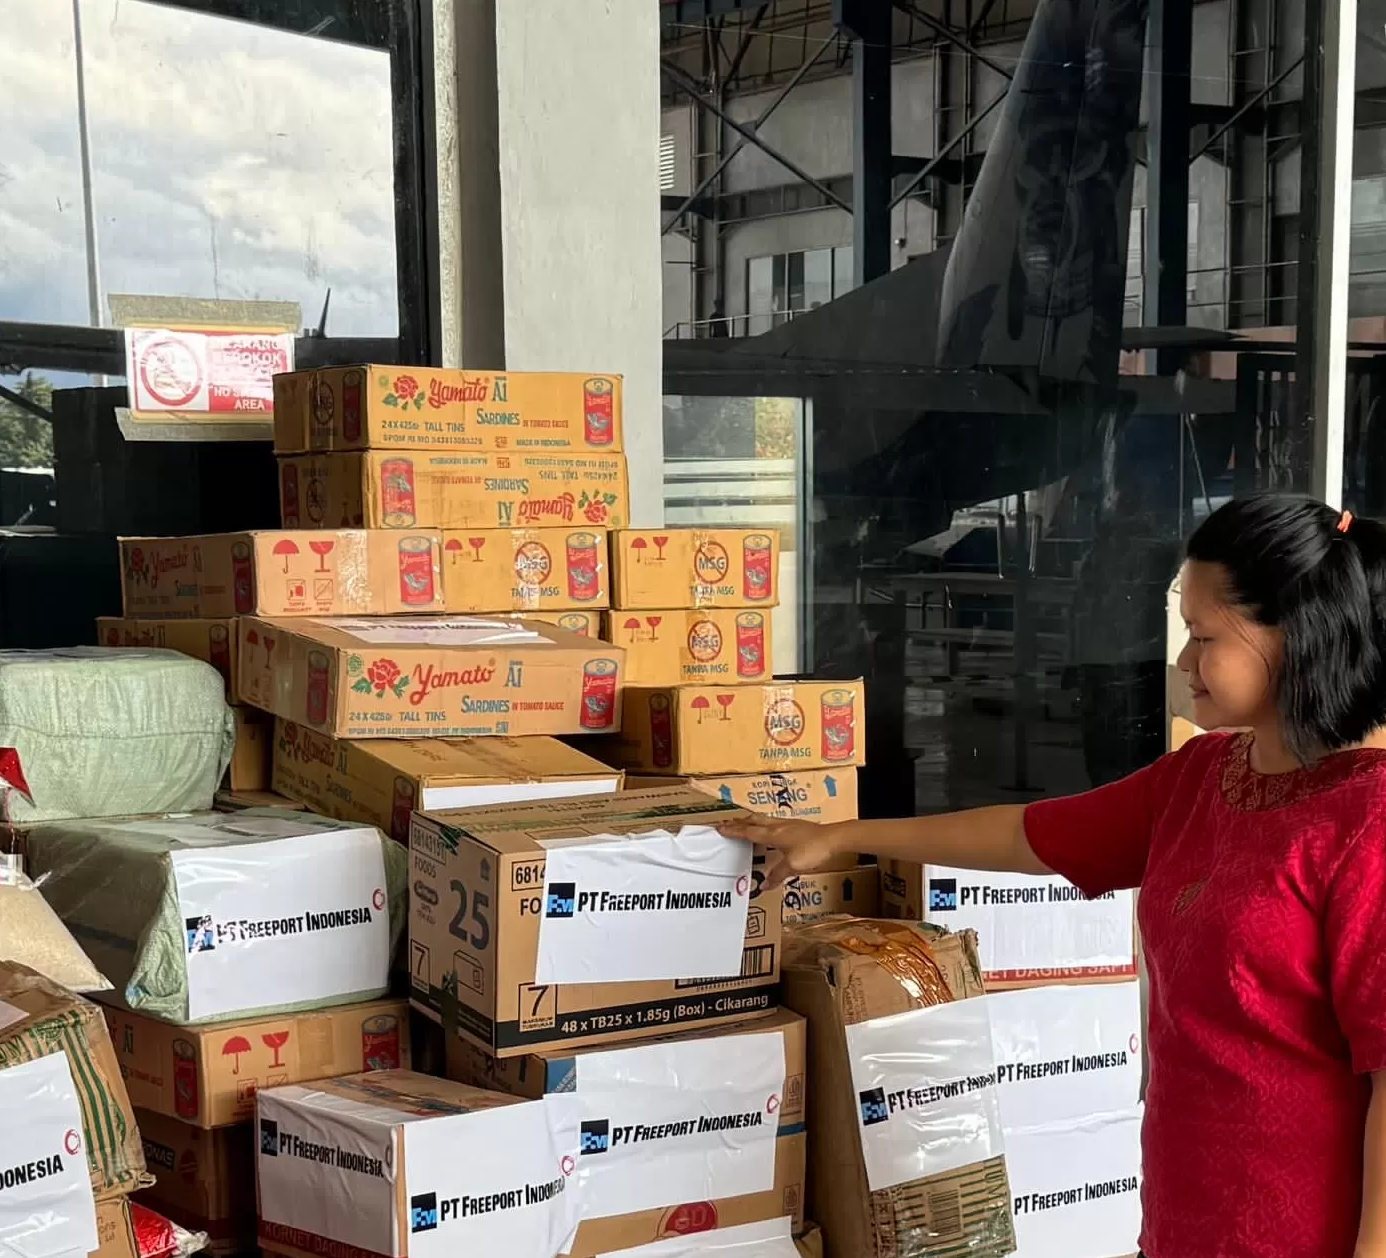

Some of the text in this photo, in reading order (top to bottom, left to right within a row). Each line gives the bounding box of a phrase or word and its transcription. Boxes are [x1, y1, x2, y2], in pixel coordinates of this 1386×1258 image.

[235, 400, 265, 410] AREA
[429, 378, 488, 409] Yamato
[477, 408, 520, 426] SARDINES
[518, 492, 575, 523] Yamato
[699, 558, 725, 573] MSG
[716, 586, 734, 595] MSG
[710, 664, 729, 673] MSG
[410, 664, 495, 706] Yamato
[461, 695, 509, 713] SARDINES
[399, 712, 446, 722] TALL TINS
[770, 714, 800, 730] MSG
[759, 748, 811, 759] TANPA MSG
[578, 889, 732, 912] PT FREEPORT INDONESIA
[960, 885, 1045, 905] PT FREEPORT
[306, 907, 372, 932] INDONESIA
[449, 879, 489, 950] 25
[415, 947, 426, 976] 7
[528, 985, 549, 1017] 7
[561, 1019, 578, 1034] 48
[580, 1022, 588, 1031] x
[590, 1013, 622, 1030] TB25
[625, 1016, 633, 1025] x
[636, 1007, 670, 1026] 1.85g
[673, 1003, 705, 1021] (Box)
[715, 993, 769, 1015] Cikarang
[997, 1052, 1127, 1083] PT FREEPORT INDONESIA
[888, 1091, 905, 1113] PT
[612, 1111, 761, 1146] PT FREEPORT INDONESIA
[279, 1132, 384, 1177] PT FREEPORT INDONESIA
[441, 1189, 523, 1222] PT FREEPORT
[1014, 1176, 1138, 1215] PT FREEPORT INDONESIA
